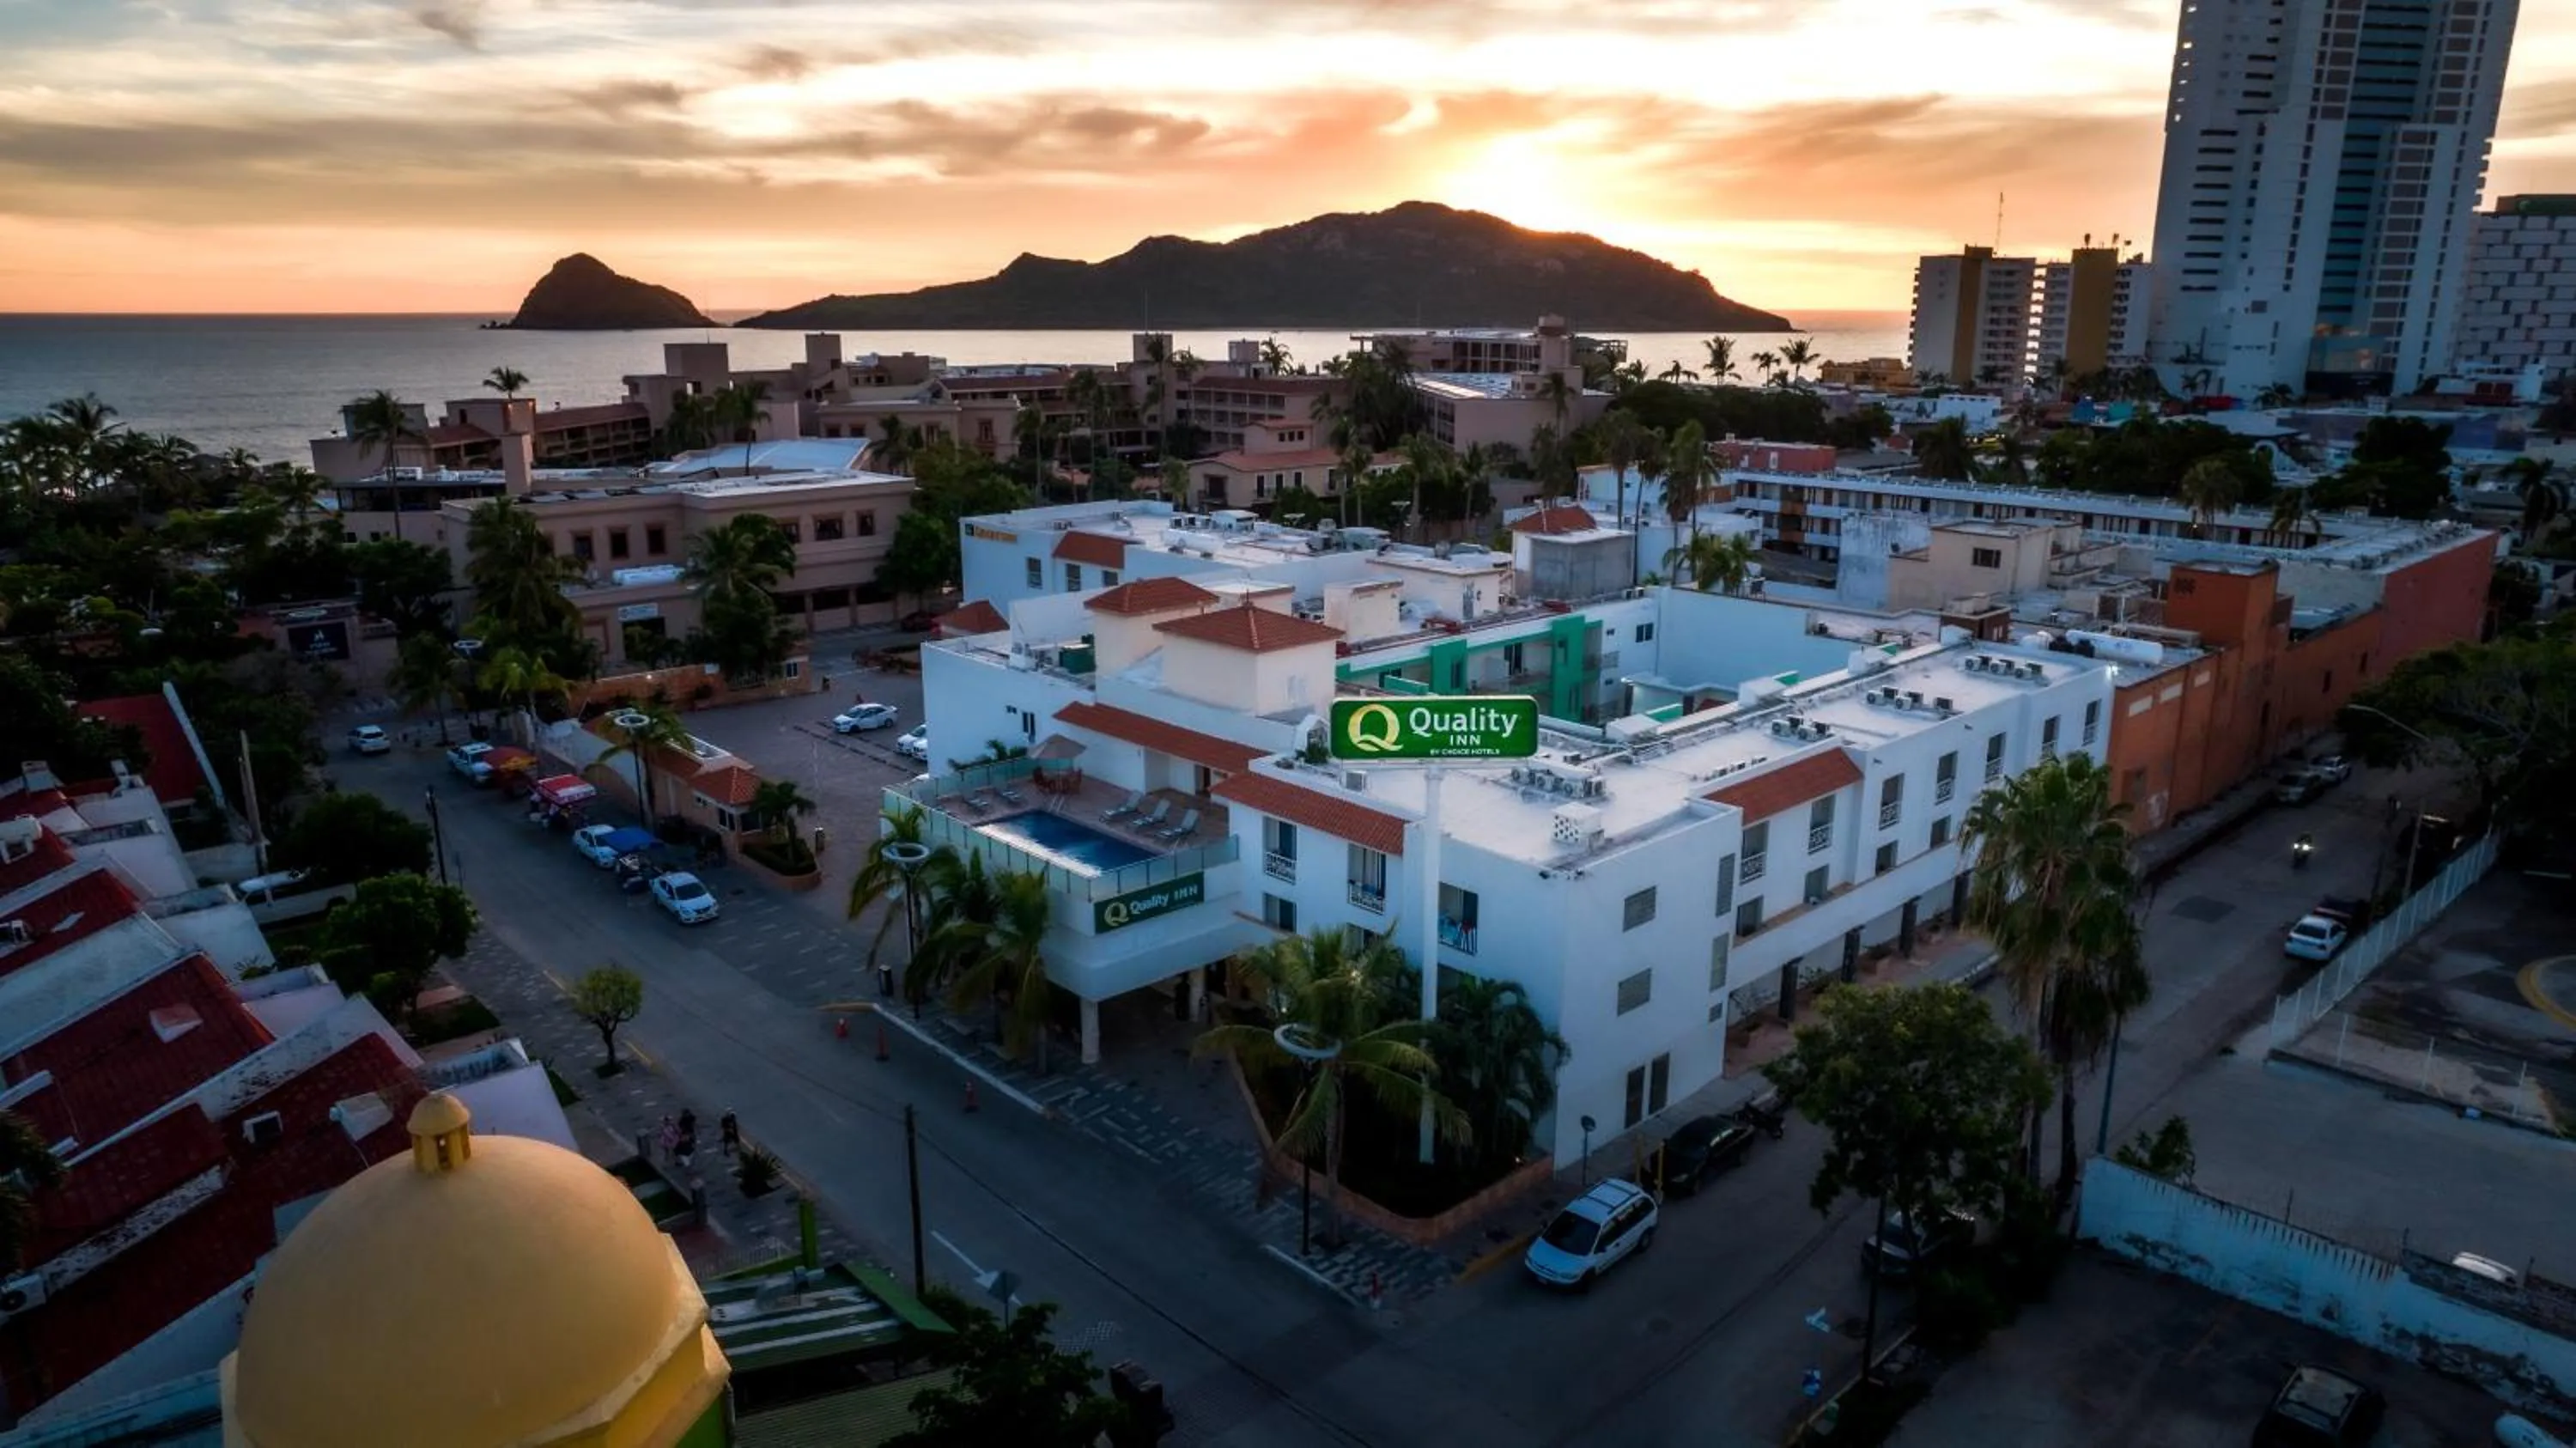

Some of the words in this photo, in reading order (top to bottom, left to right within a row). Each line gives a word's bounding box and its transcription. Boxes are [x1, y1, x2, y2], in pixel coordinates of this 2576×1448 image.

[1409, 707, 1518, 738] Quality
[1449, 734, 1481, 745] INN
[1130, 893, 1170, 916] Quality
